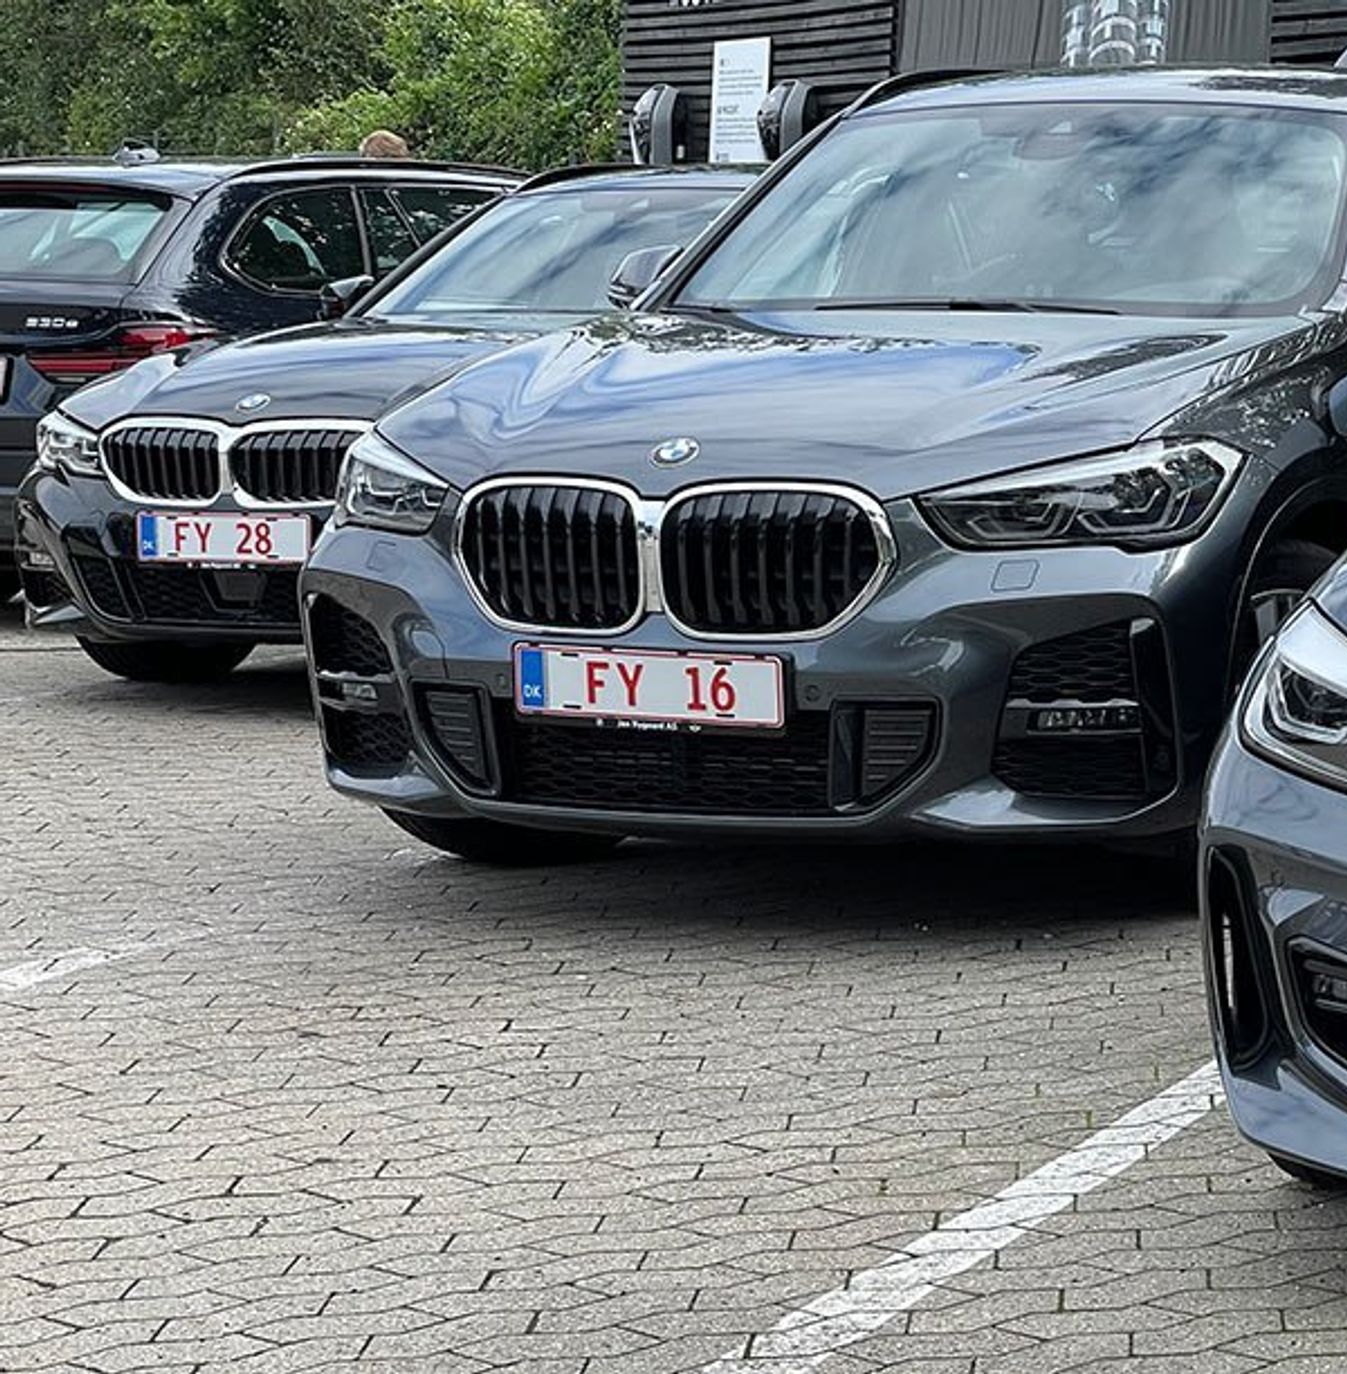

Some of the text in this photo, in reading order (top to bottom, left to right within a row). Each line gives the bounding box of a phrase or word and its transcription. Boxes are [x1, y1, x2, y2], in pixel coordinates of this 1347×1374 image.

[174, 522, 273, 554] FY 28
[523, 684, 542, 699] DK
[586, 661, 736, 711] FY 16
